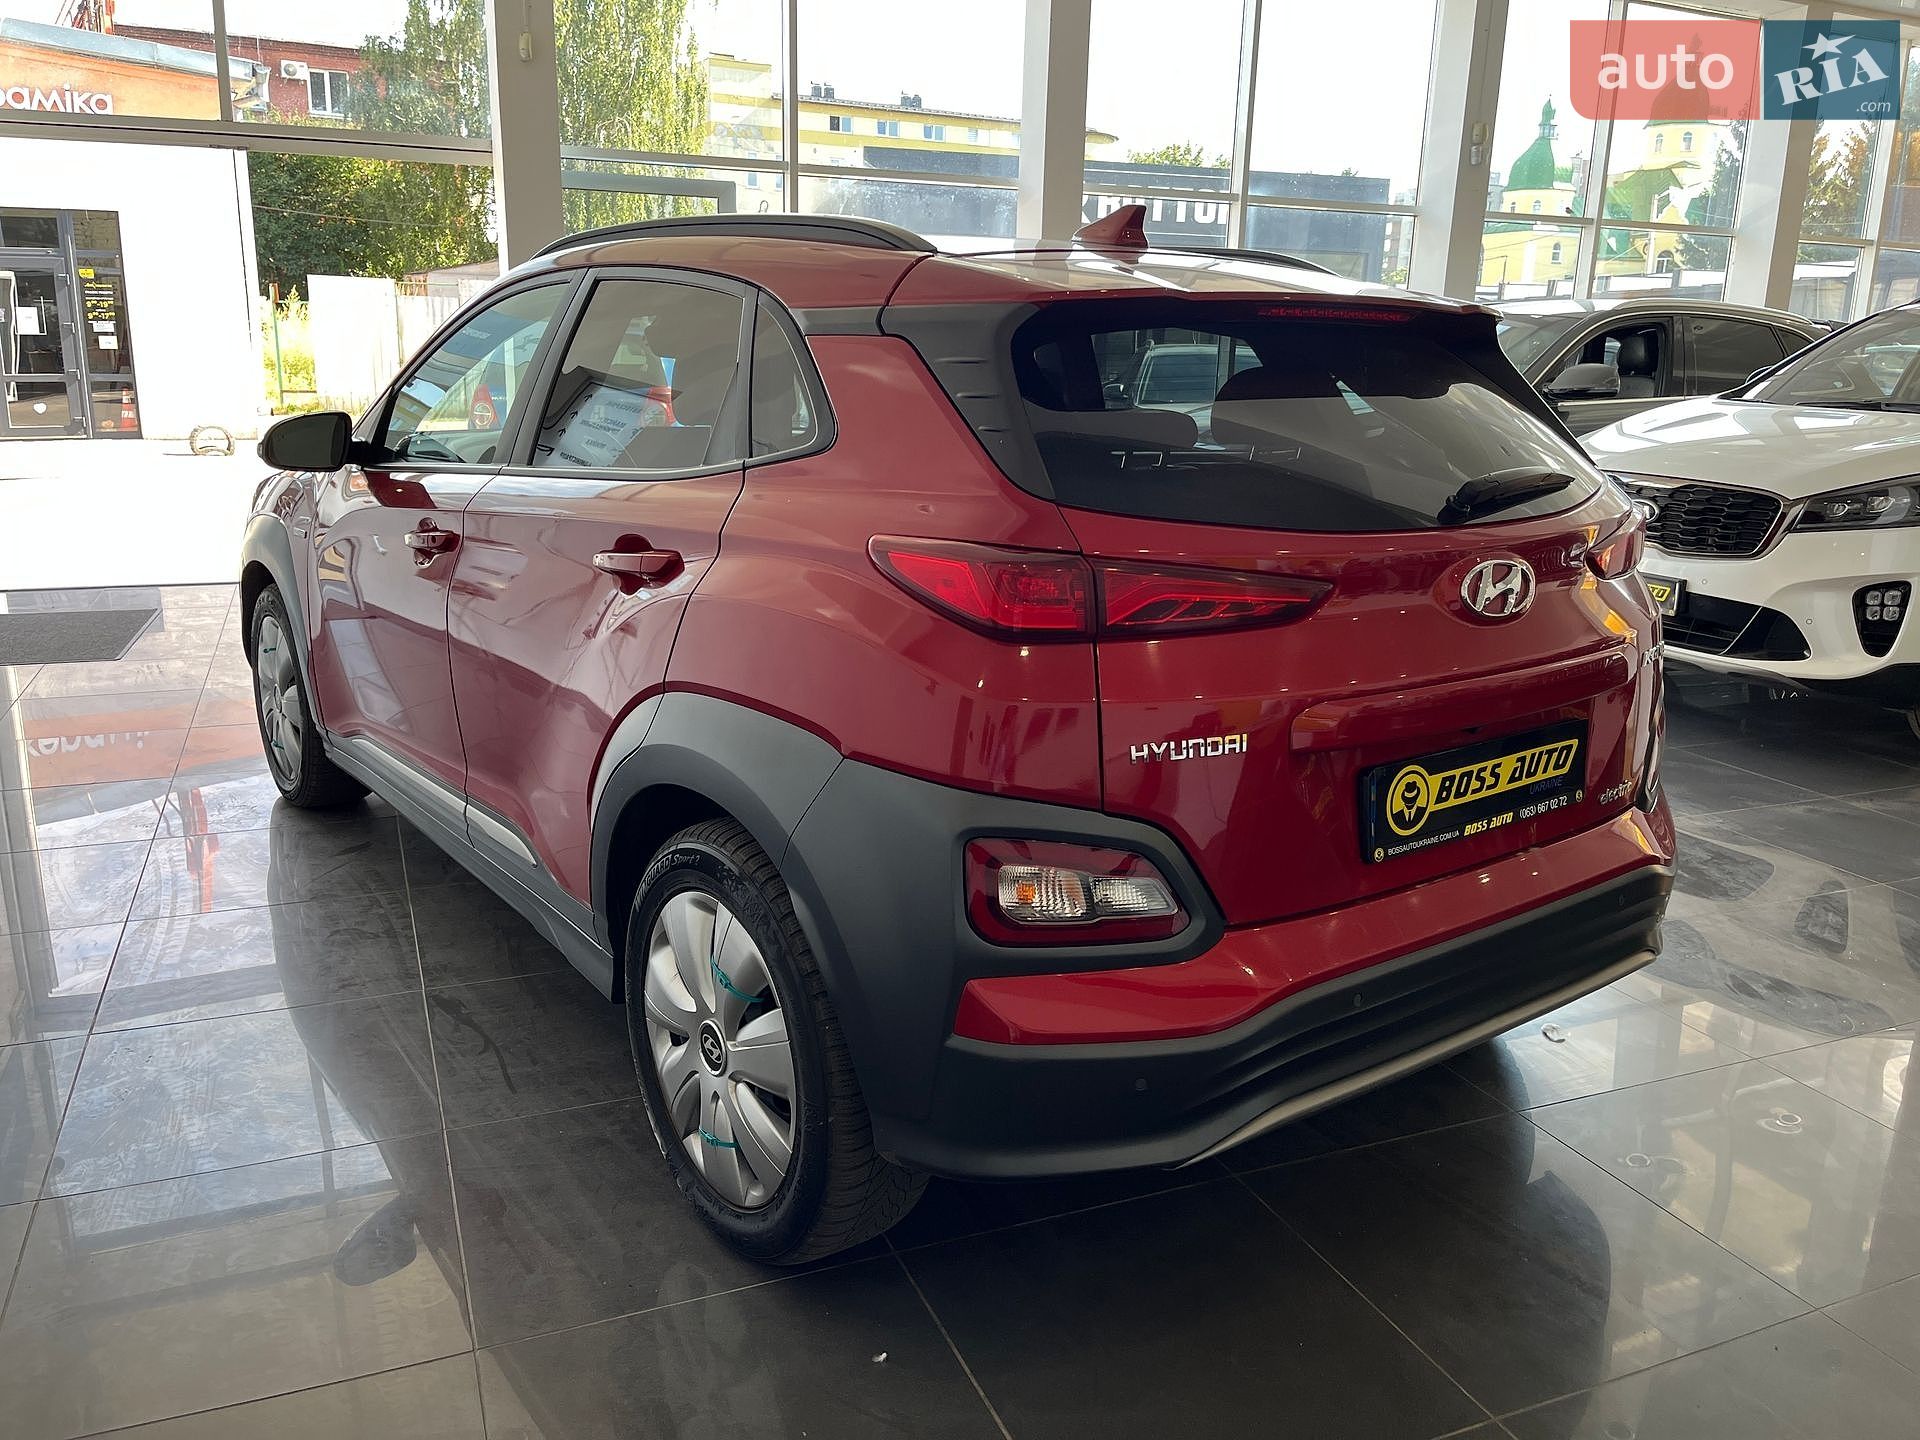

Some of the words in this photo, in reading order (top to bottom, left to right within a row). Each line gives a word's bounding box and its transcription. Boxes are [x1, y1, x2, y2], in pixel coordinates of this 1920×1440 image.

[1130, 733, 1248, 764] HYUNDAI
[1434, 762, 1503, 806] BOSS
[1506, 744, 1574, 786] AUTO
[1529, 776, 1564, 795] UKRAINE
[1520, 805, 1536, 819] (063)
[1537, 801, 1549, 814] 667
[1550, 798, 1559, 810] 02
[1559, 796, 1568, 807] 72
[1464, 819, 1488, 837] BOSS
[1490, 811, 1513, 829] AUTO
